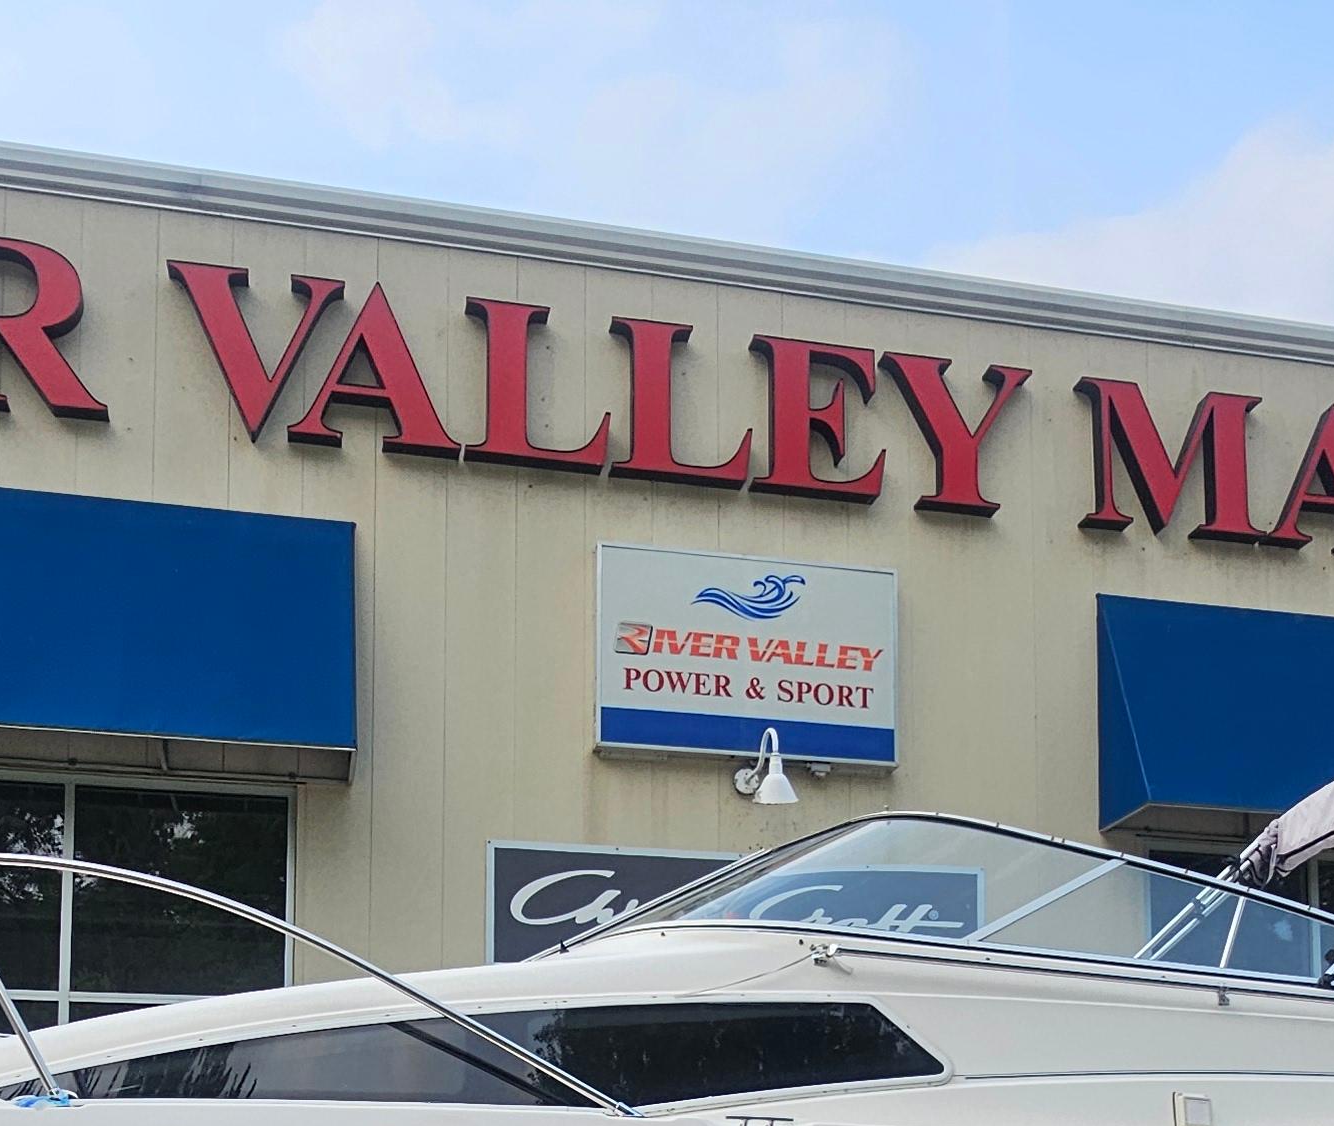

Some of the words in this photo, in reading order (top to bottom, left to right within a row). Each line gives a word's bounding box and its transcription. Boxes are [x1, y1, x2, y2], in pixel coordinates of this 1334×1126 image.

[165, 259, 1033, 518] VALLEY
[615, 621, 740, 661] RIVER
[747, 636, 884, 672] VALLEY
[623, 667, 733, 698] POWER
[745, 677, 766, 700] &
[777, 679, 874, 709] SPORT
